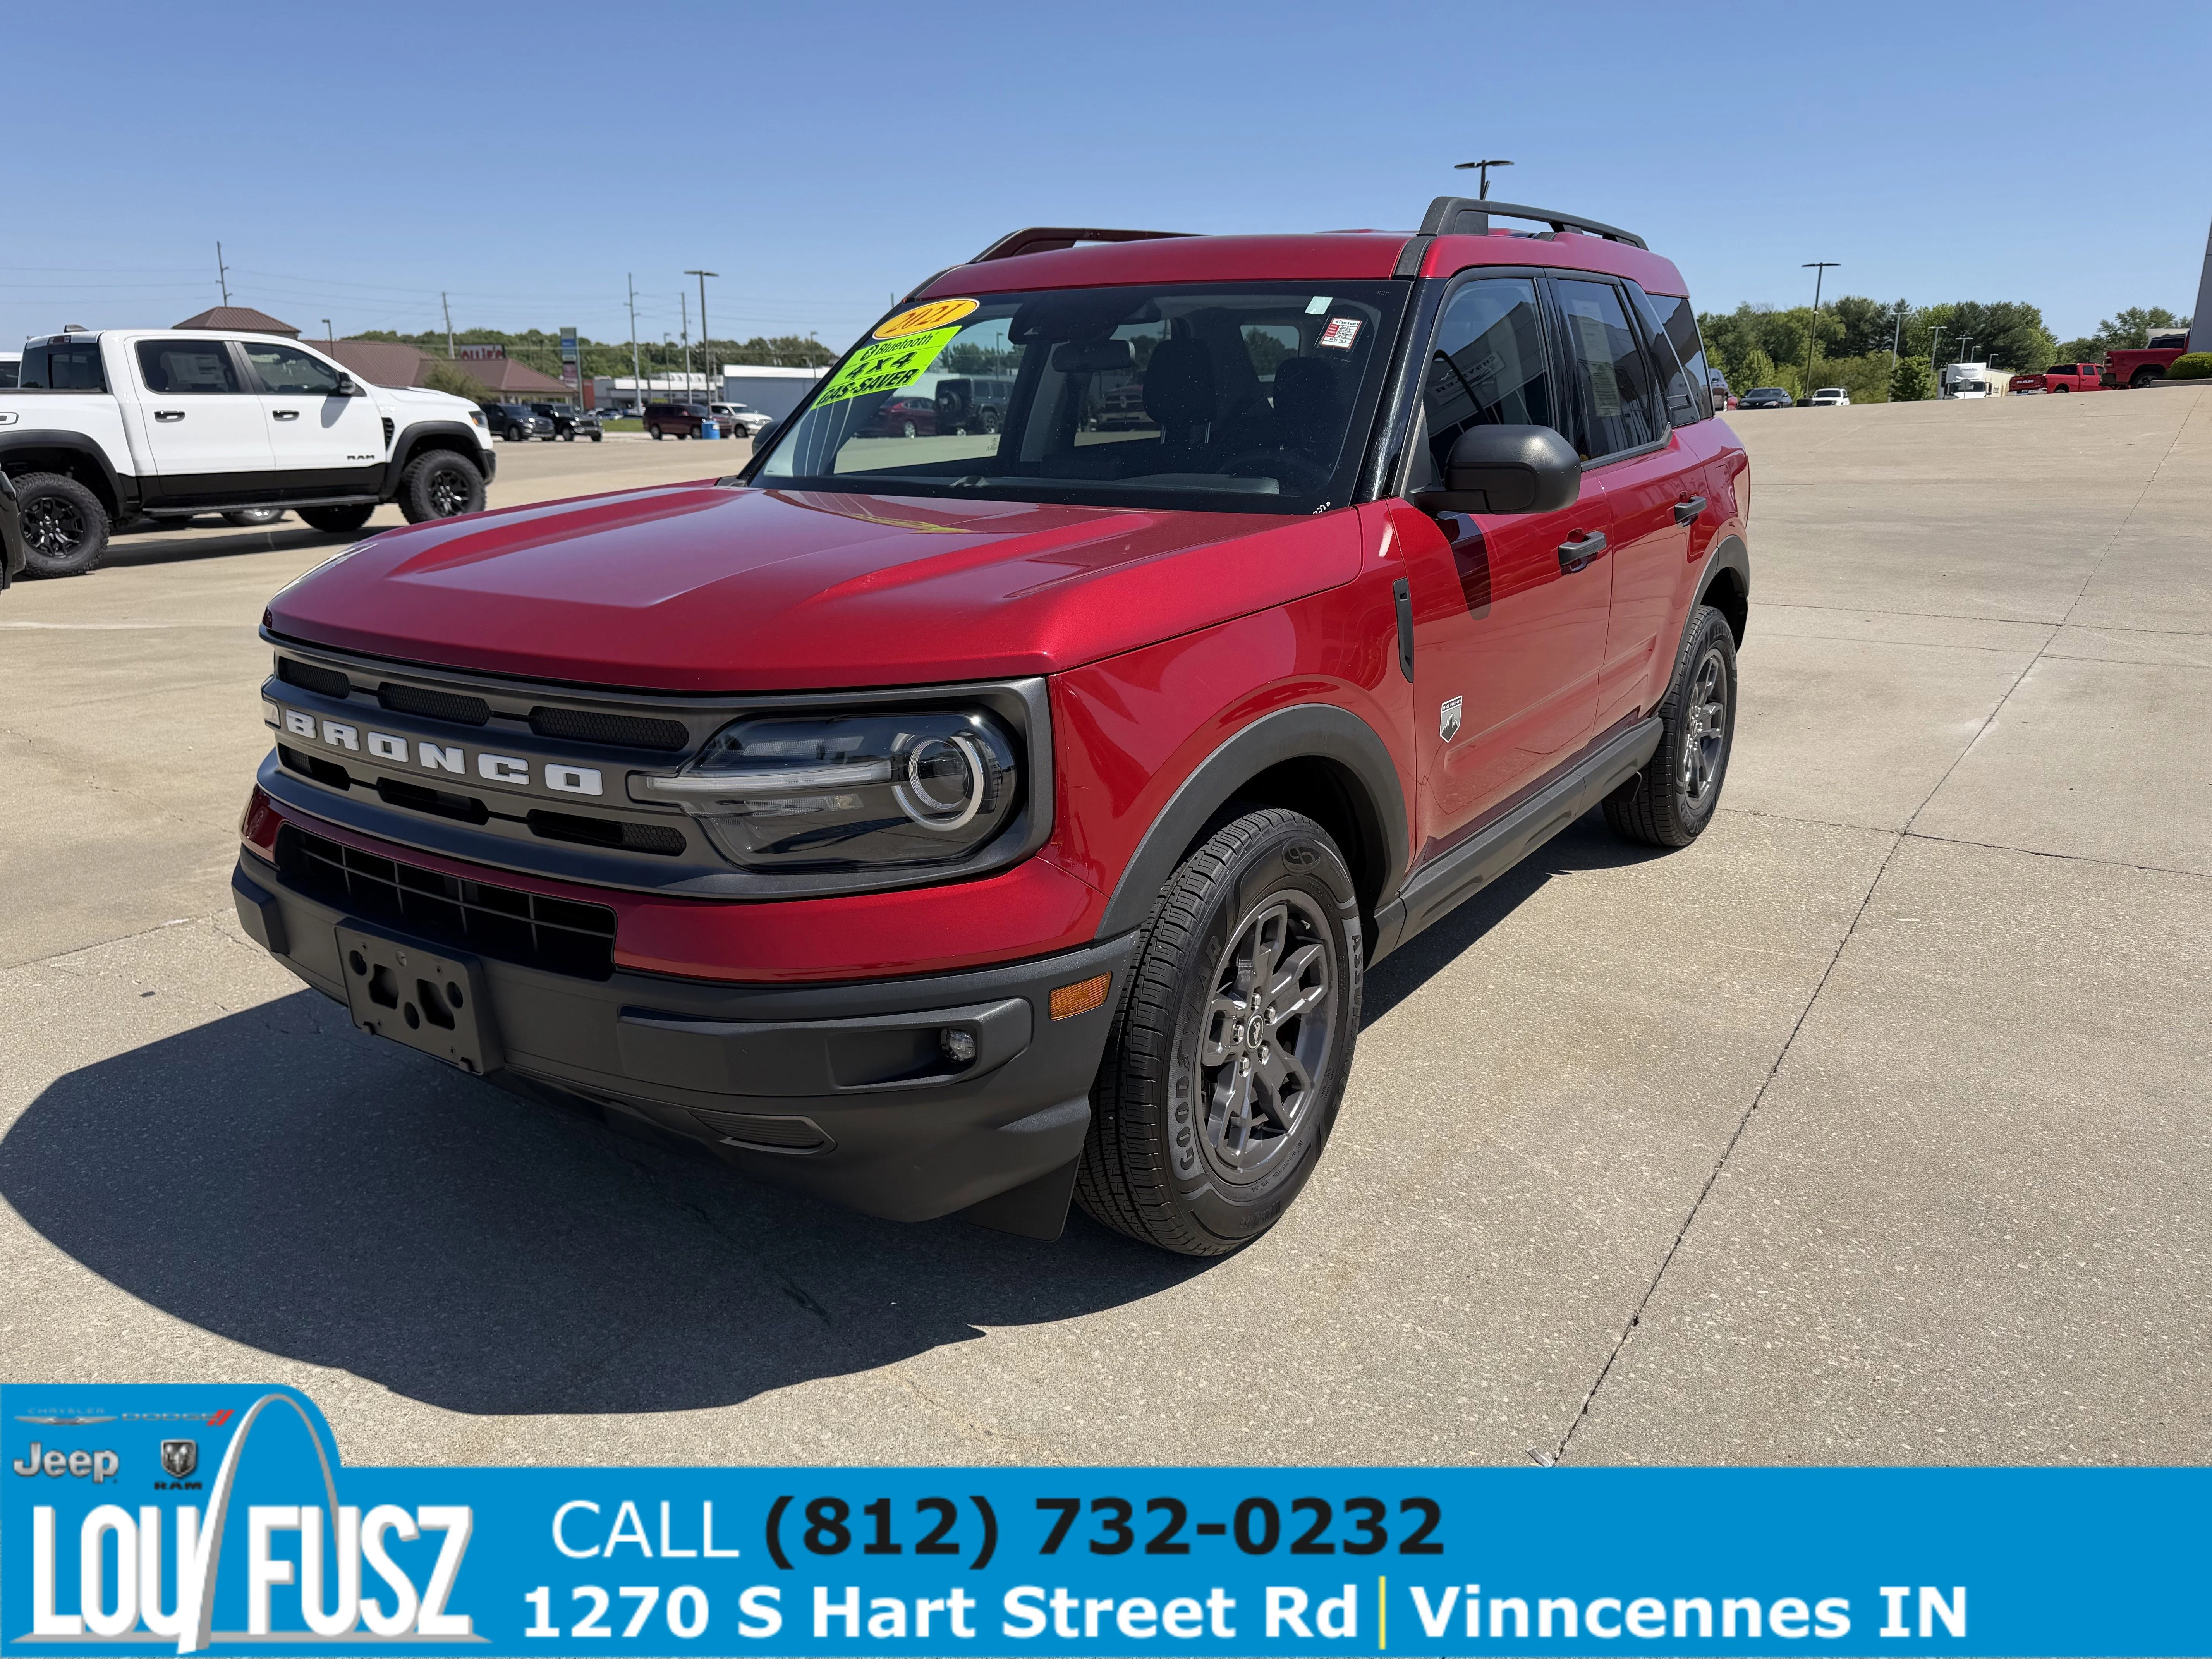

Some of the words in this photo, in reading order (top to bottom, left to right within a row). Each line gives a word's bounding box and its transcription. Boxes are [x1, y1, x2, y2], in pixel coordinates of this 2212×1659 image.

[884, 302, 967, 334] 2021
[874, 334, 935, 356] Bluetooth
[845, 362, 870, 381] 4
[891, 351, 918, 370] 4
[816, 368, 921, 407] GAS-SAVER
[286, 709, 603, 796] BRONCO
